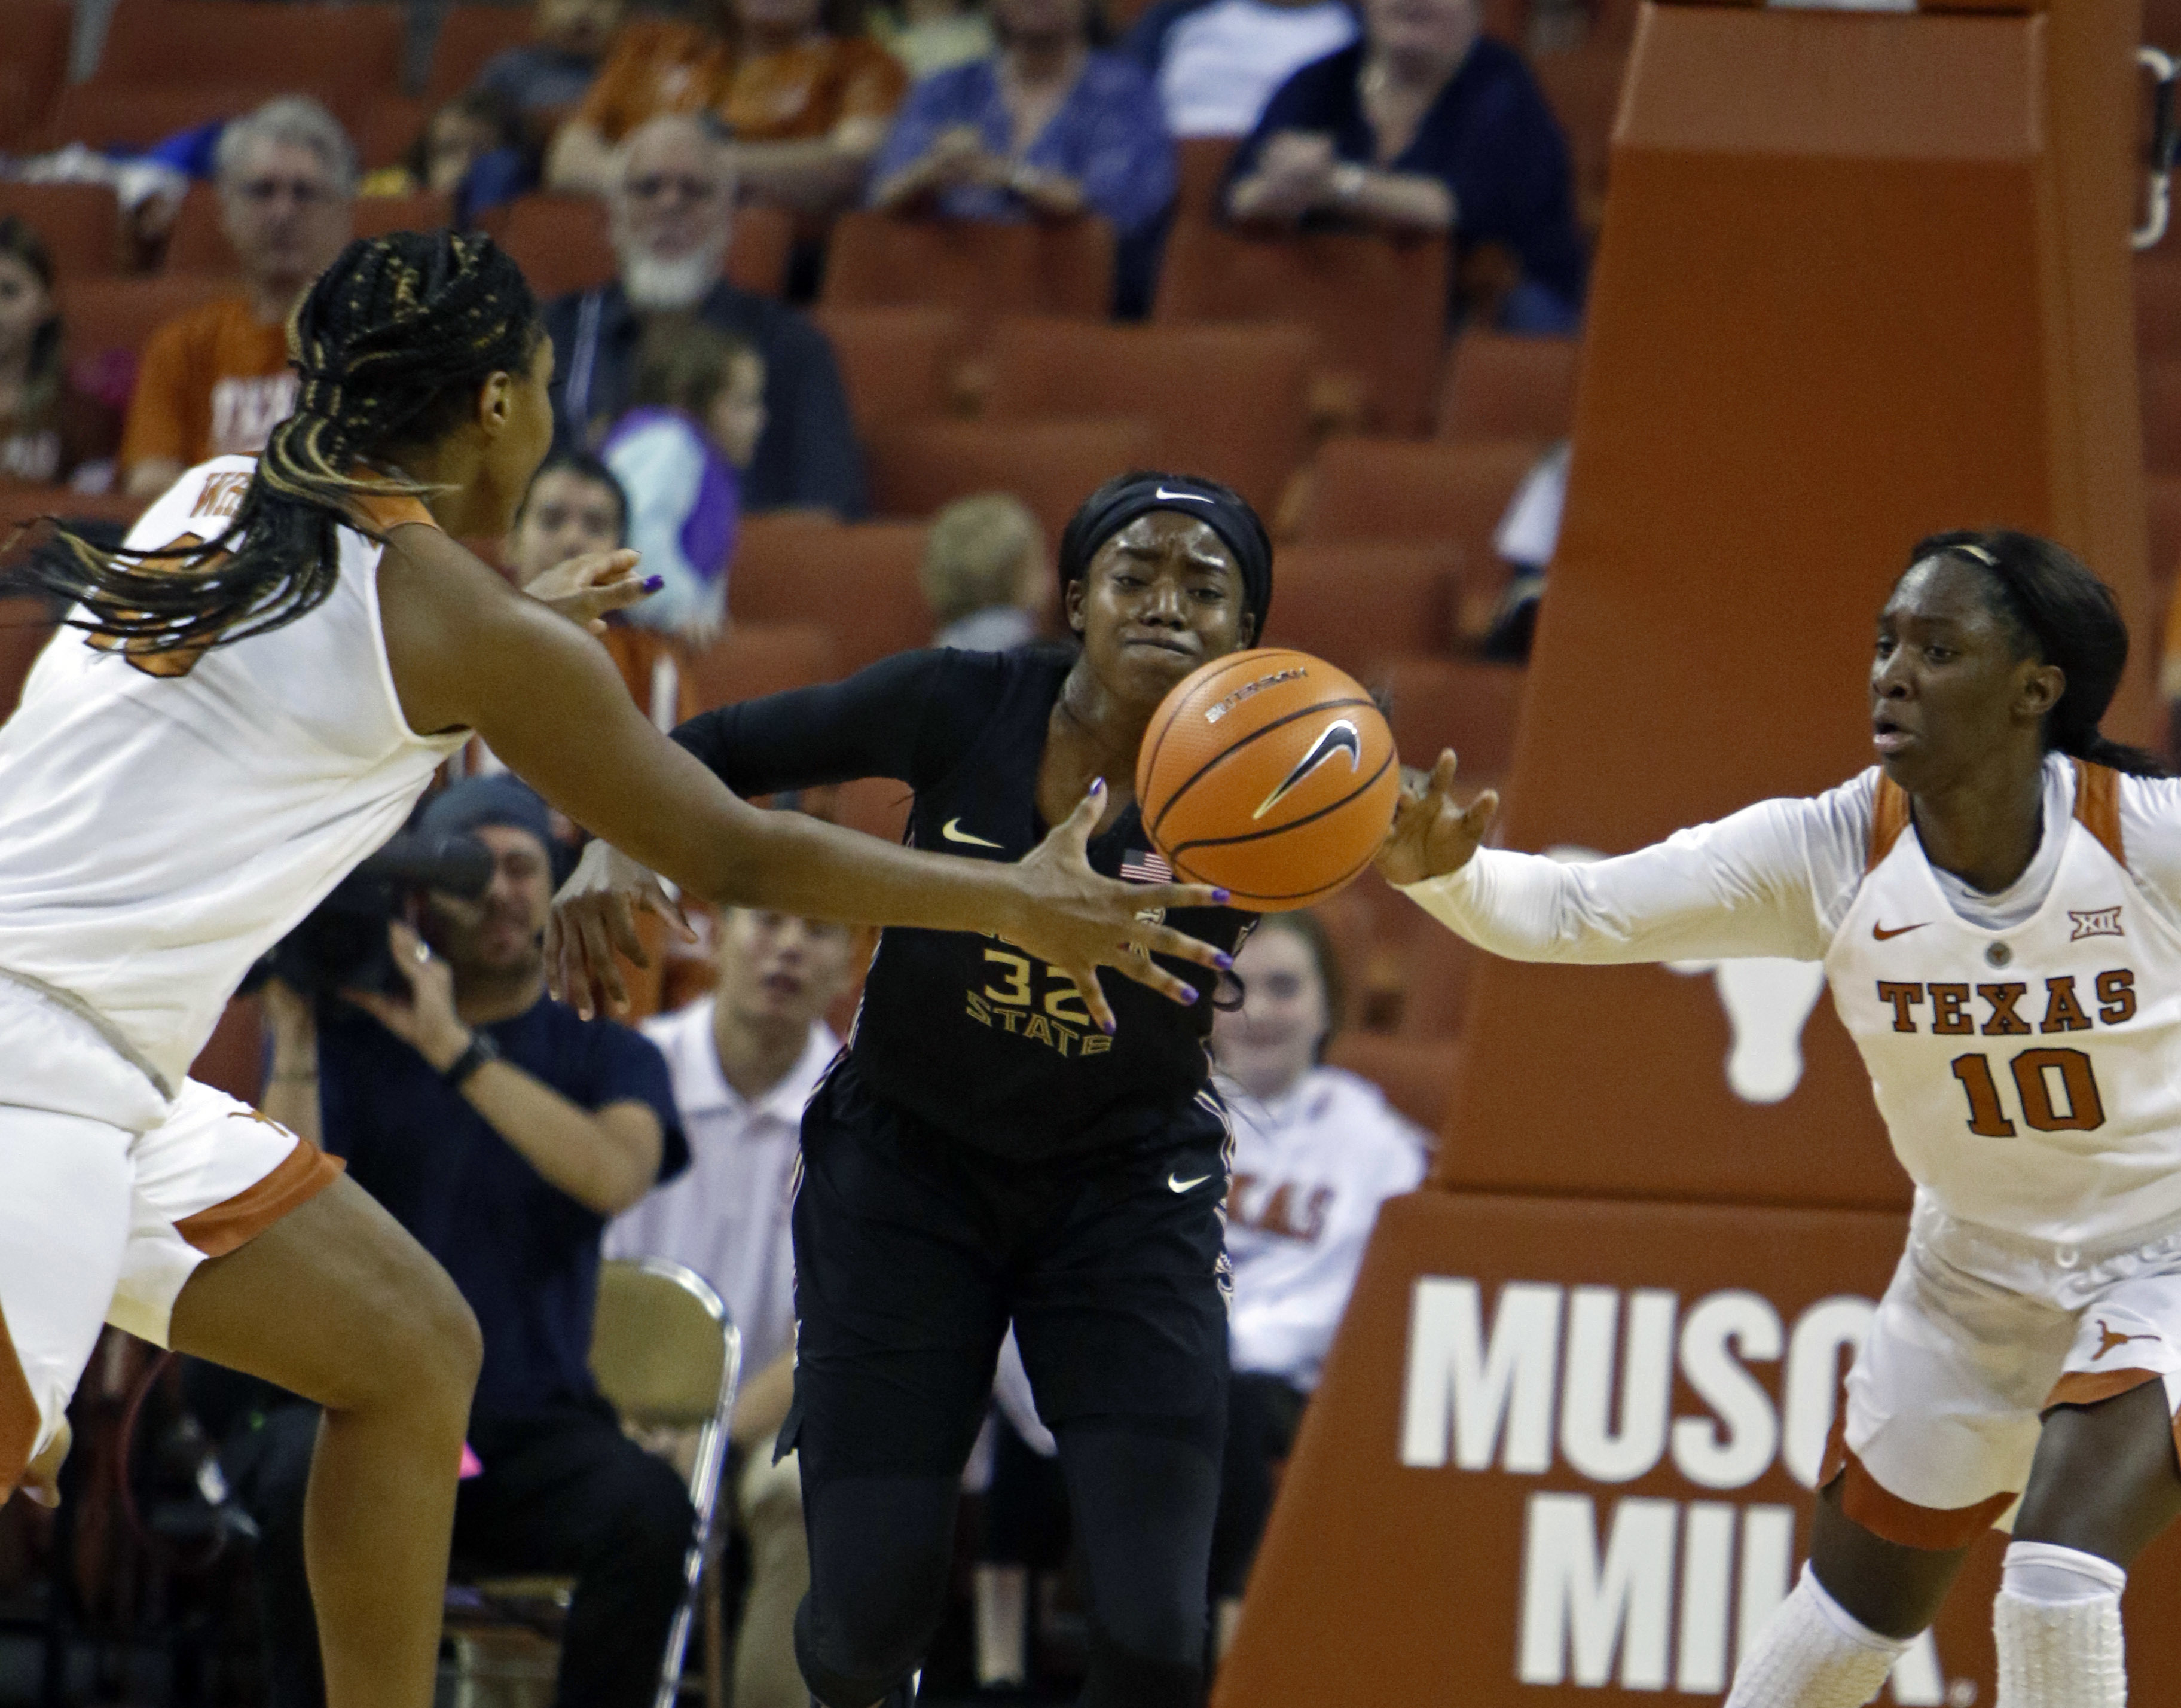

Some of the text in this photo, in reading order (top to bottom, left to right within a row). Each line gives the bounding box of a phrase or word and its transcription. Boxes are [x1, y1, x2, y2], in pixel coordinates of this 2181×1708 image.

[966, 989, 1113, 1058] STATE
[984, 948, 1091, 1026] 32
[1876, 968, 2138, 1036] TEXAS
[1950, 1047, 2107, 1138] 10
[1400, 1274, 1881, 1492] MUSC
[1517, 1492, 1944, 1707] MIL
